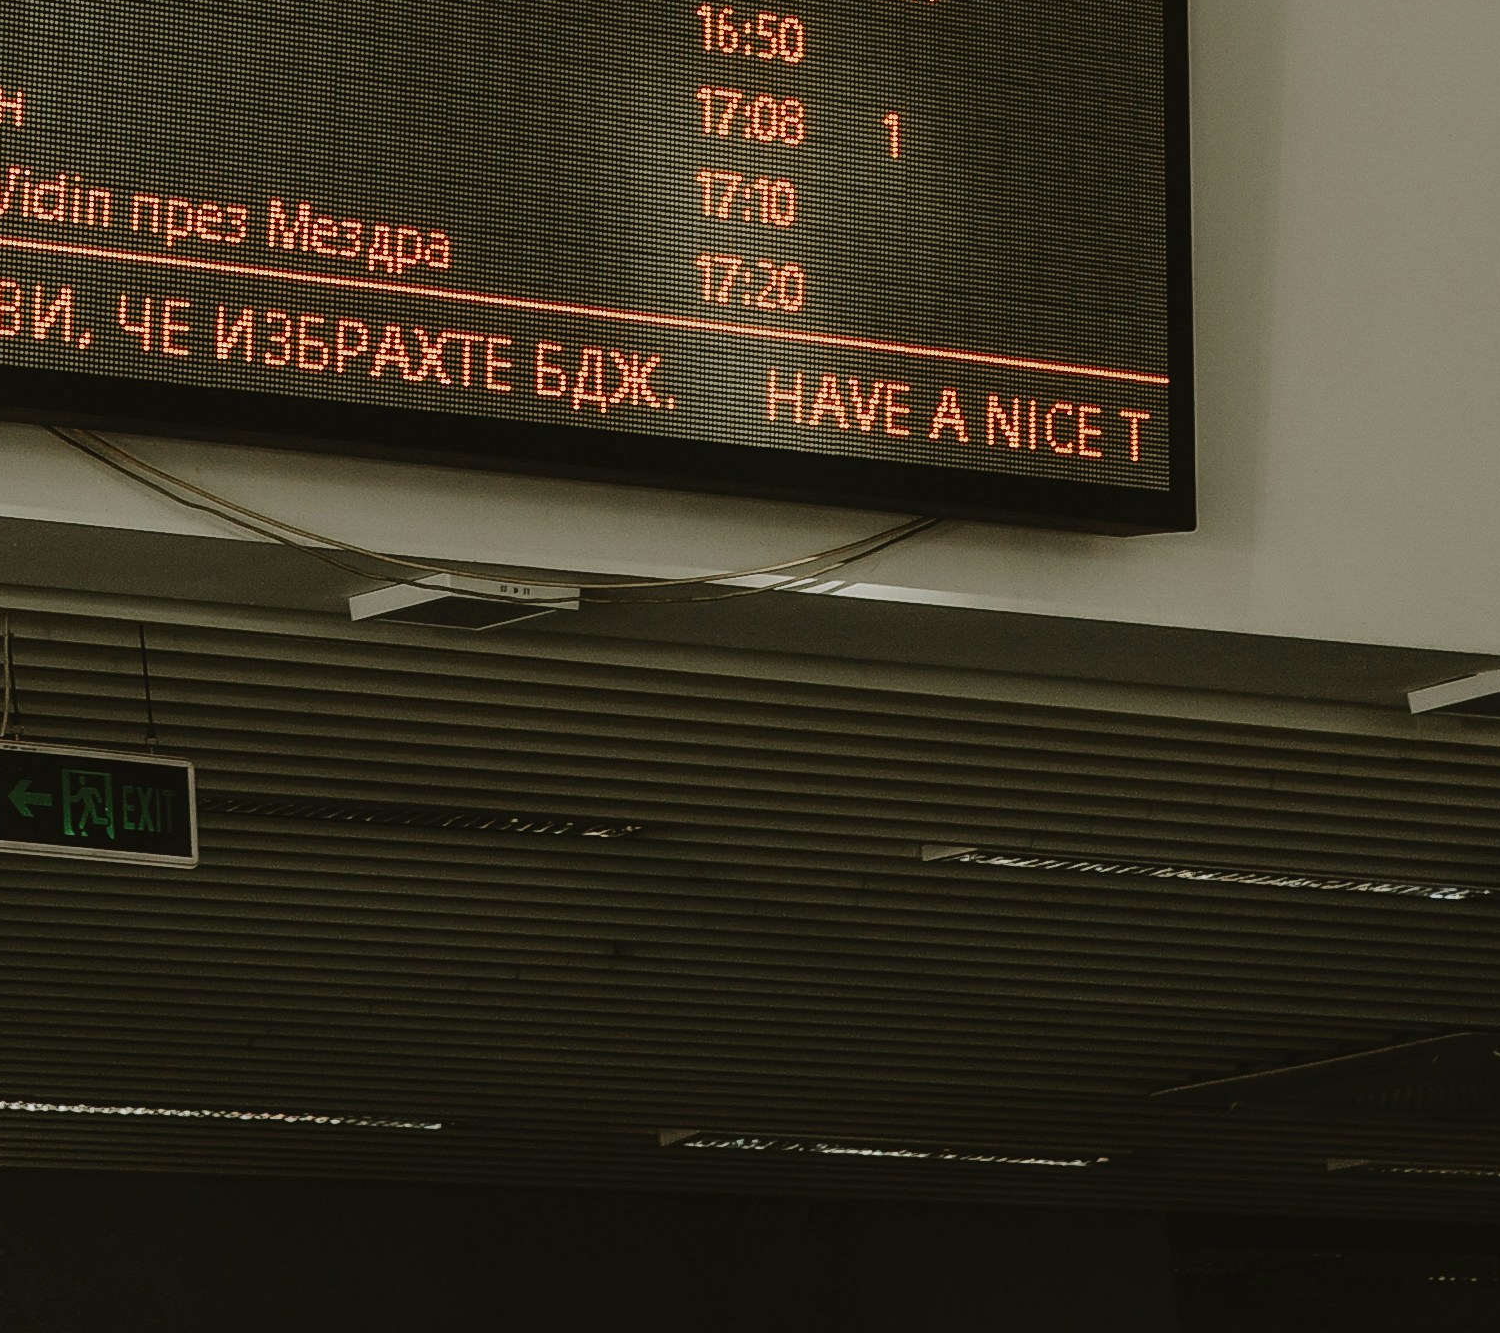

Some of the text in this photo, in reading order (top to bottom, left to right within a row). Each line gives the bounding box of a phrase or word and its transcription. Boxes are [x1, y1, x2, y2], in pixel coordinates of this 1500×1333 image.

[696, 4, 807, 64] 16:50
[696, 85, 808, 148] 17:08
[881, 113, 902, 158] 1
[693, 167, 798, 230] 17:10
[129, 192, 250, 244] през
[265, 199, 453, 270] Мездра
[694, 251, 807, 315] 17:20
[116, 294, 192, 356] ЧЕ
[216, 305, 513, 392] ИЗБРАХТЕ
[535, 340, 677, 414] БДЖ.
[765, 369, 912, 436] HAVE
[928, 389, 970, 443] A
[985, 395, 1103, 458] NICE
[1118, 409, 1151, 462] T
[123, 785, 175, 835] EXIT
